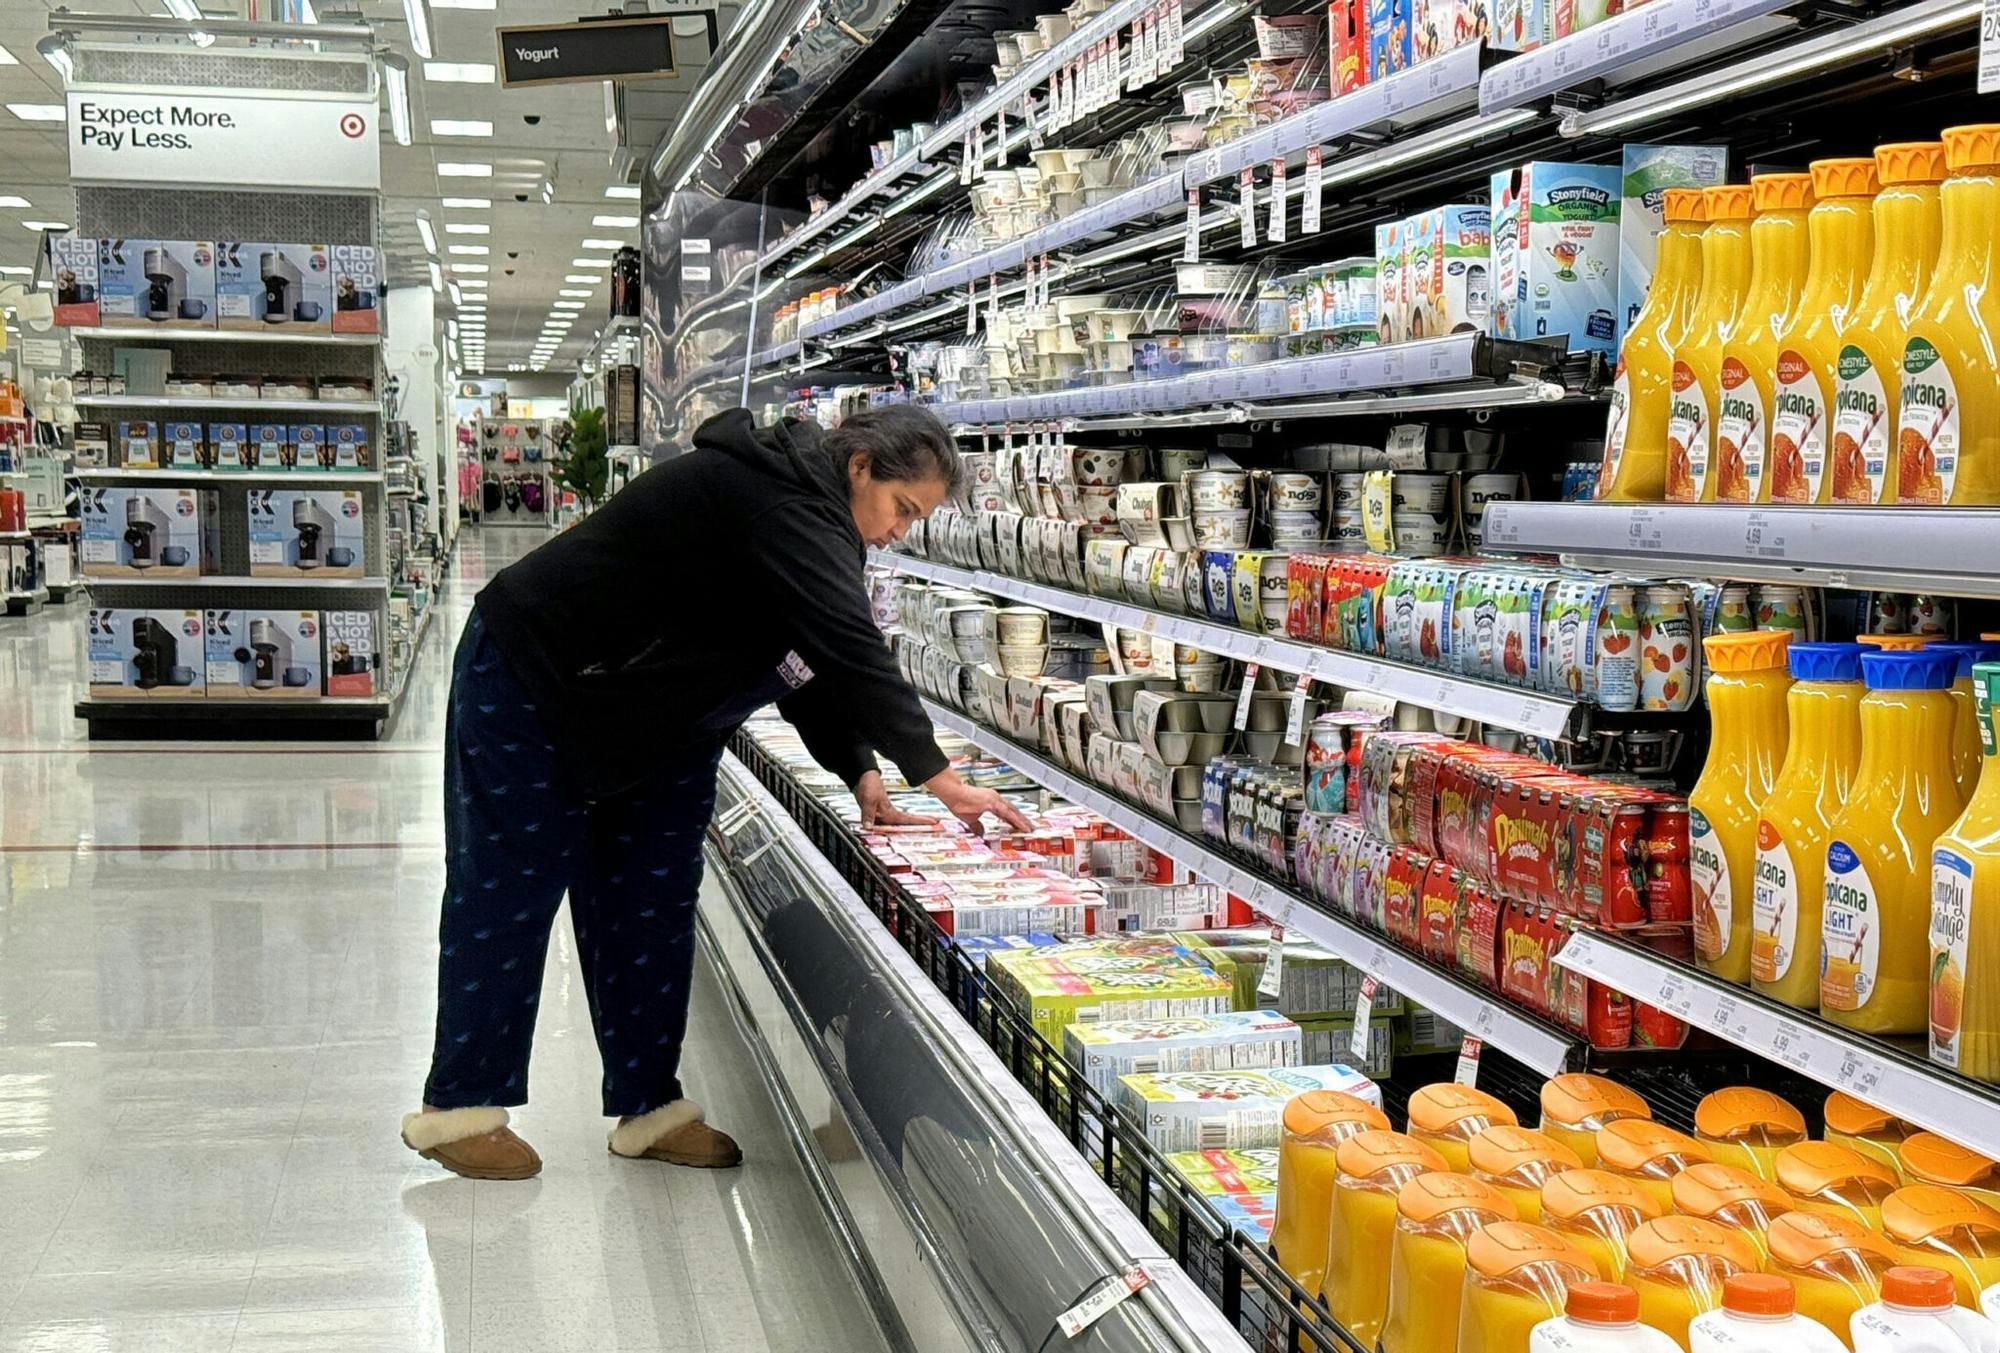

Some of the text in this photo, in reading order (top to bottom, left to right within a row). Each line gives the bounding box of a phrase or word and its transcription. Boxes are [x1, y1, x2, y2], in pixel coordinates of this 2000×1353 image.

[515, 47, 559, 63] Yogurt
[80, 103, 236, 128] Expect More.
[81, 125, 193, 151] Pay Less.
[1551, 187, 1606, 204] Stonyfield
[1558, 202, 1598, 212] ORGANIC
[1563, 213, 1595, 221] YOGURT
[51, 239, 97, 252] ICED
[1459, 230, 1490, 247] bab
[67, 254, 97, 266] HOT
[332, 245, 376, 261] ICED
[344, 261, 376, 273] HOT
[1839, 357, 1868, 368] OMESTYLE
[1904, 349, 1936, 361] OMESTYLE
[1837, 384, 1877, 415] picana
[1902, 377, 1946, 409] picana
[1671, 395, 1700, 423] icana
[1776, 387, 1815, 418] picana
[1287, 489, 1317, 502] noosa
[1261, 576, 1288, 591] noos
[326, 611, 370, 625] ICED
[338, 627, 370, 638] HOT
[1494, 808, 1549, 856] Danimals
[1690, 841, 1719, 871] picana
[1755, 854, 1786, 889] picana
[1755, 886, 1774, 905] GHT
[1825, 909, 1853, 931] LIGHT
[1505, 924, 1544, 971] Danimals
